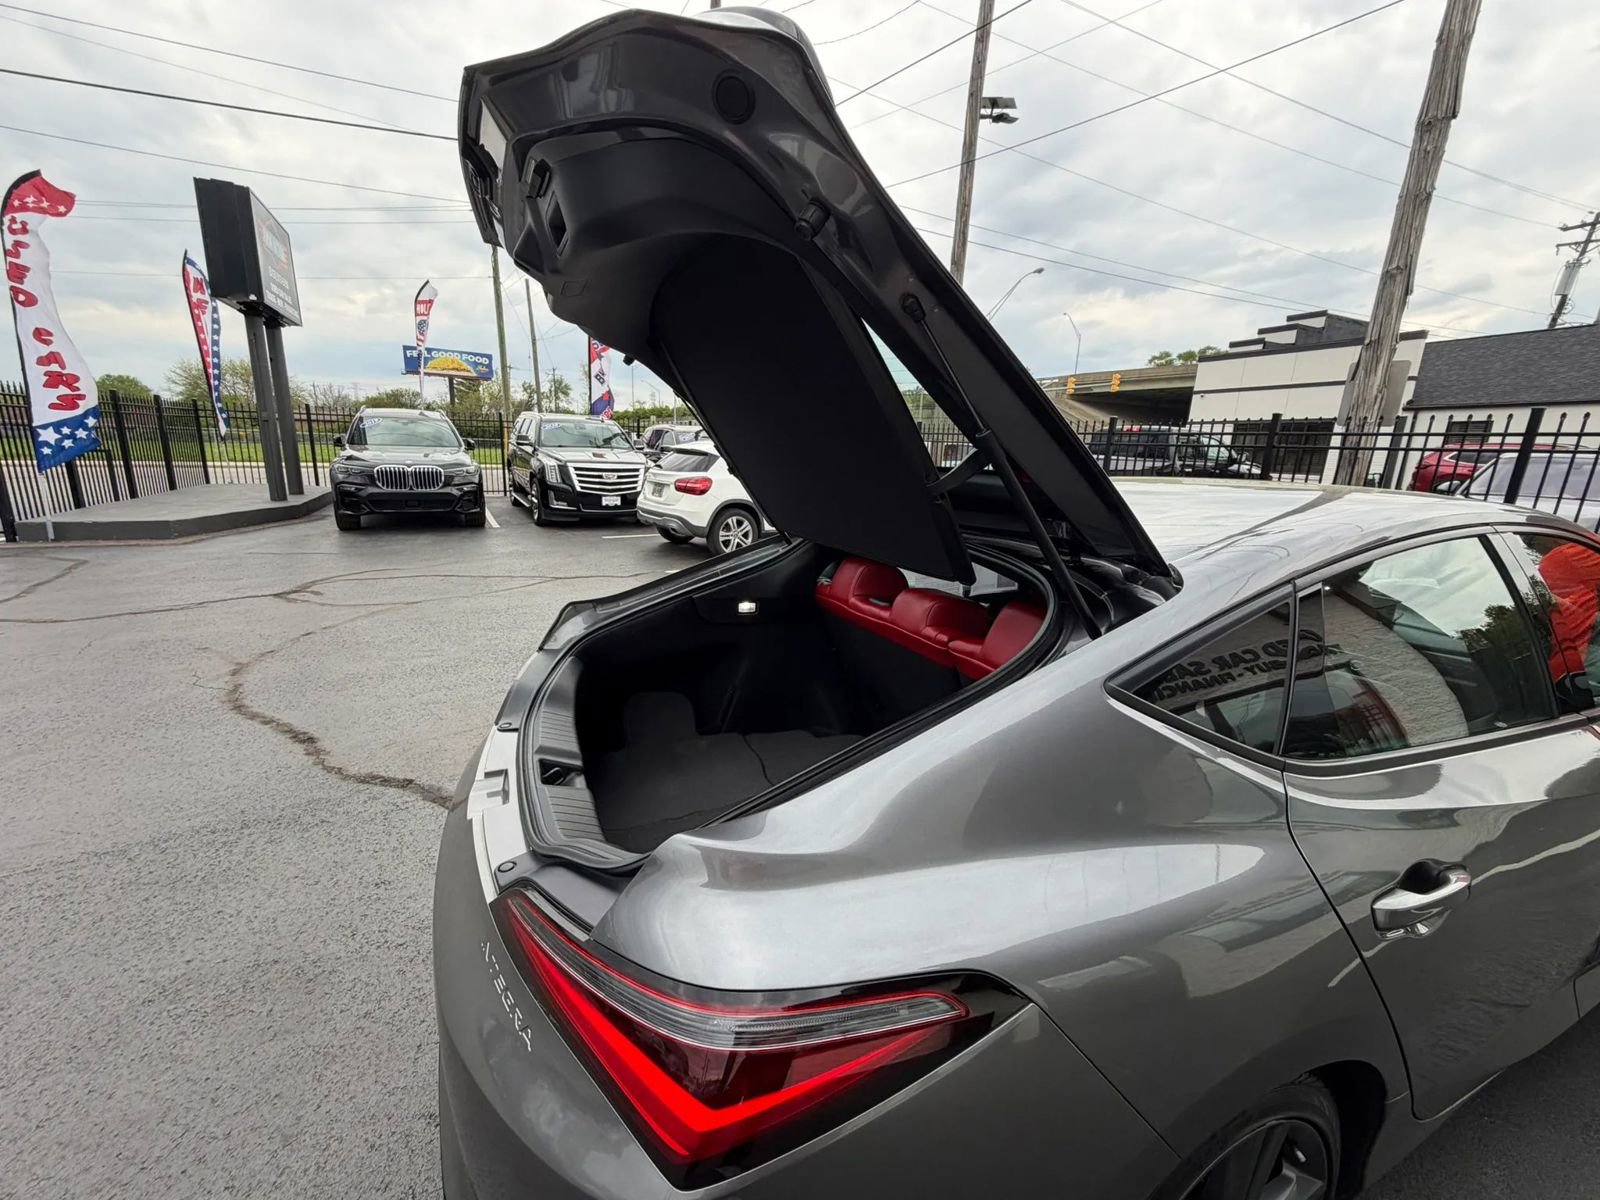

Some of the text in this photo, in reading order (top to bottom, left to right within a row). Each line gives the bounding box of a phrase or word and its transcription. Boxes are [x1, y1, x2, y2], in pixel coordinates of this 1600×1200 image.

[32, 326, 87, 411] CARS
[431, 350, 461, 360] GOOD
[462, 353, 489, 365] FOOD
